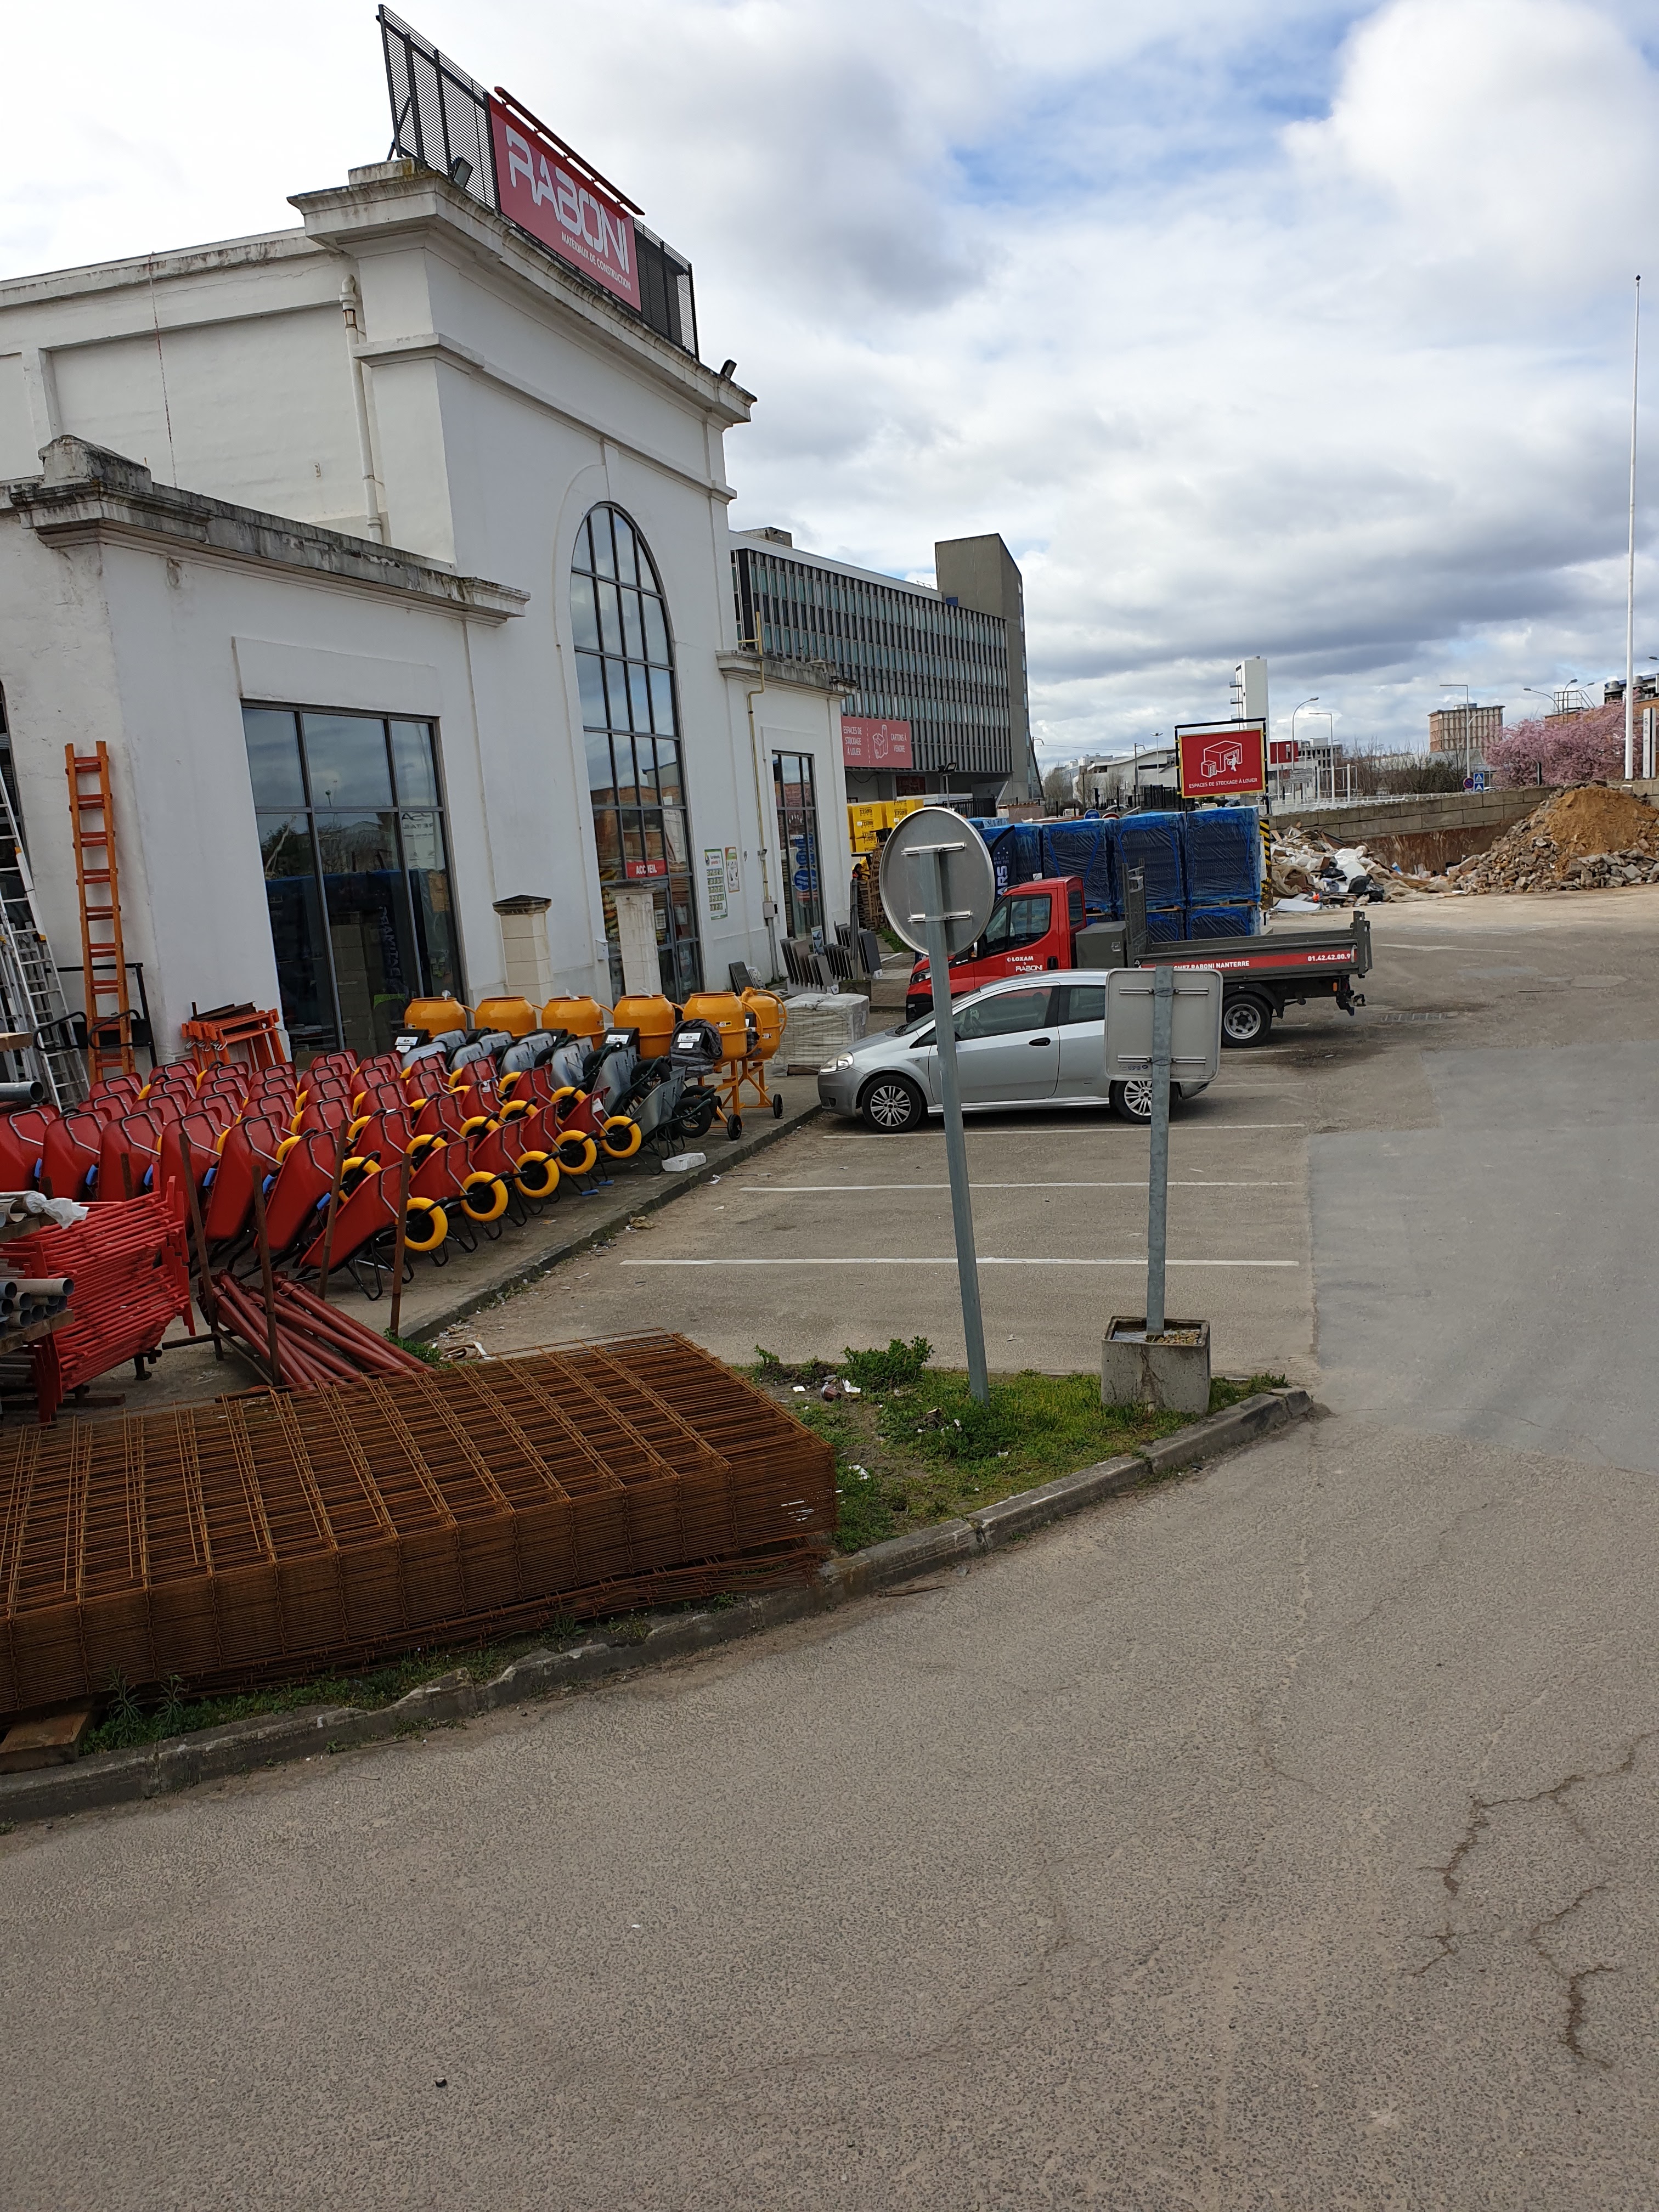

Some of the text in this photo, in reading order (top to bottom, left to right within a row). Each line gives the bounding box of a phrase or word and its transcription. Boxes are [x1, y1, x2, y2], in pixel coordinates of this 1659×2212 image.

[505, 125, 629, 274] RABONI
[561, 231, 631, 291] MATÉRIAUX DE CONSTRUCTION
[843, 726, 857, 735] ESPACES
[845, 737, 862, 745] STOCKAGE
[1307, 953, 1351, 962] 01.42.42.00.9
